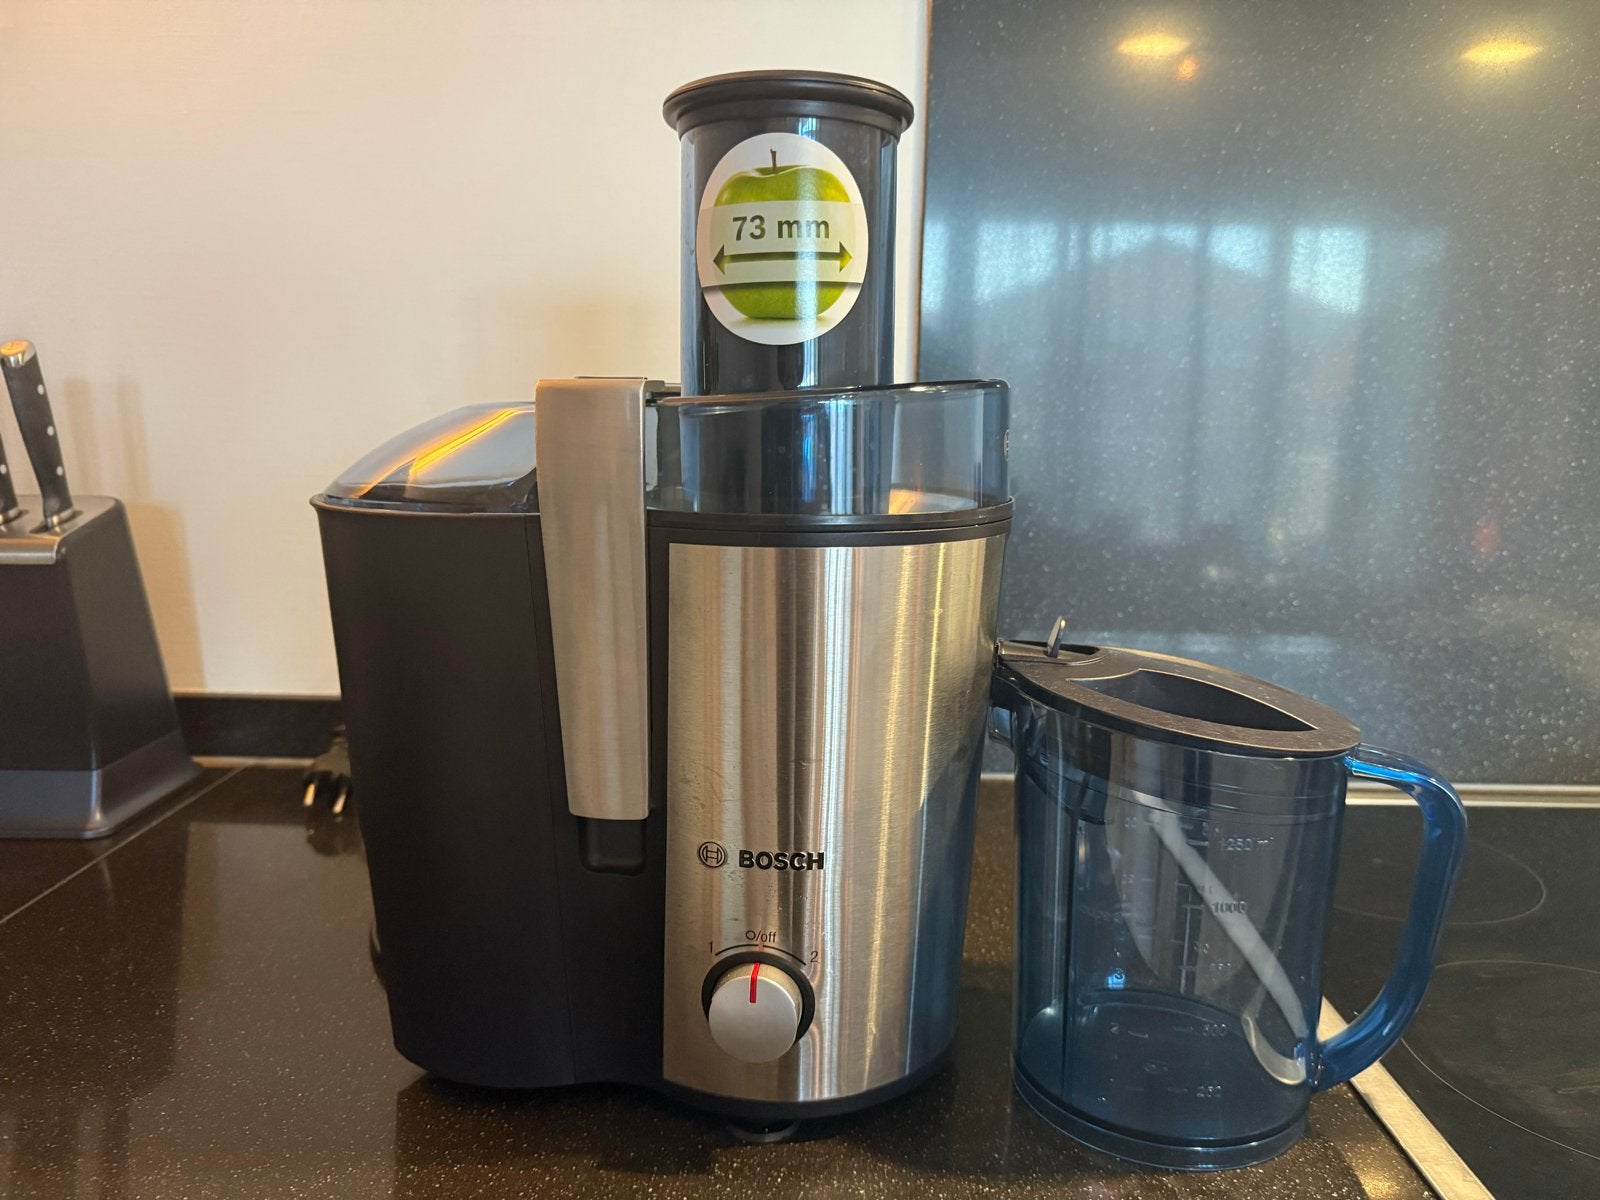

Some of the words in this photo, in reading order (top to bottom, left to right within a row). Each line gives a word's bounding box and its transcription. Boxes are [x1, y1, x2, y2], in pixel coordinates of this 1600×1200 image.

[732, 214, 766, 241] 73
[777, 218, 830, 239] mm
[738, 849, 825, 871] BOSCH
[1212, 900, 1247, 914] 1000
[810, 951, 819, 963] 2
